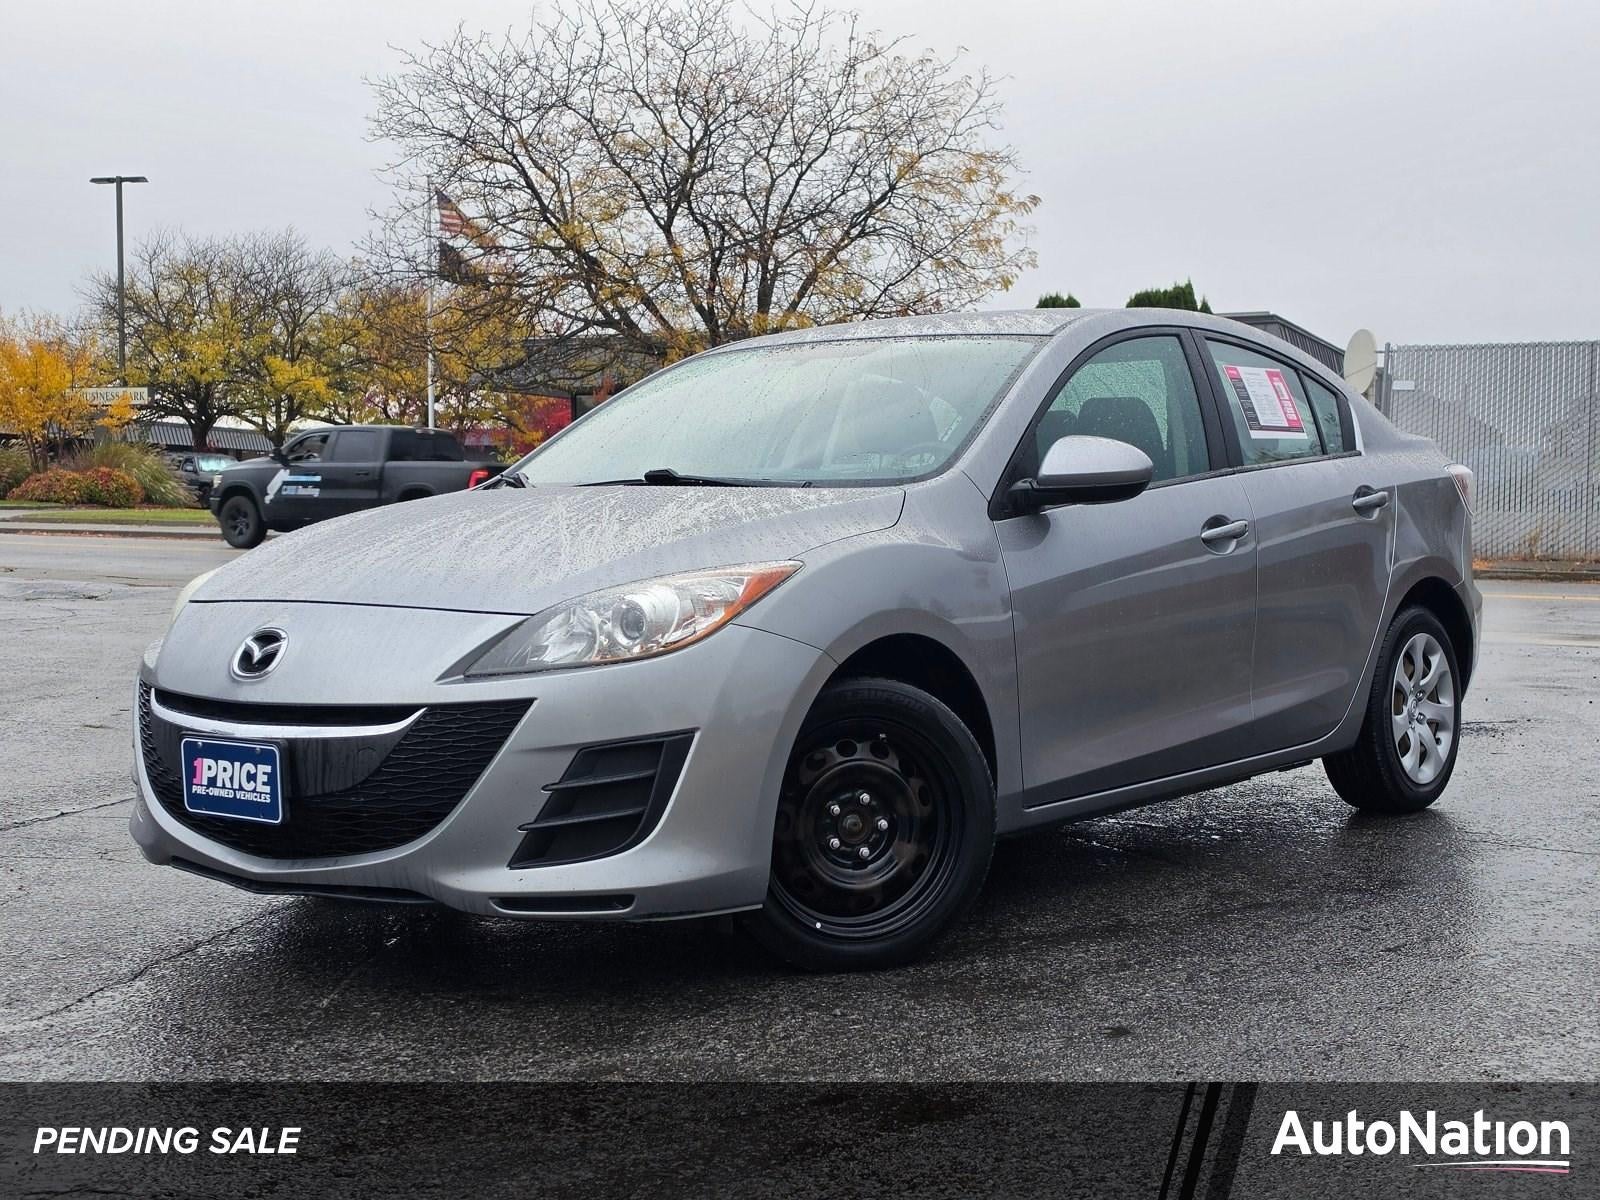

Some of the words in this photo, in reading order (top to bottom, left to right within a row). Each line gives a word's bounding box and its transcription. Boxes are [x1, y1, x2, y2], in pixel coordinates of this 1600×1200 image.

[122, 391, 145, 401] ARK
[192, 785, 235, 799] PRE-OWNED
[235, 790, 272, 803] VEHICLES
